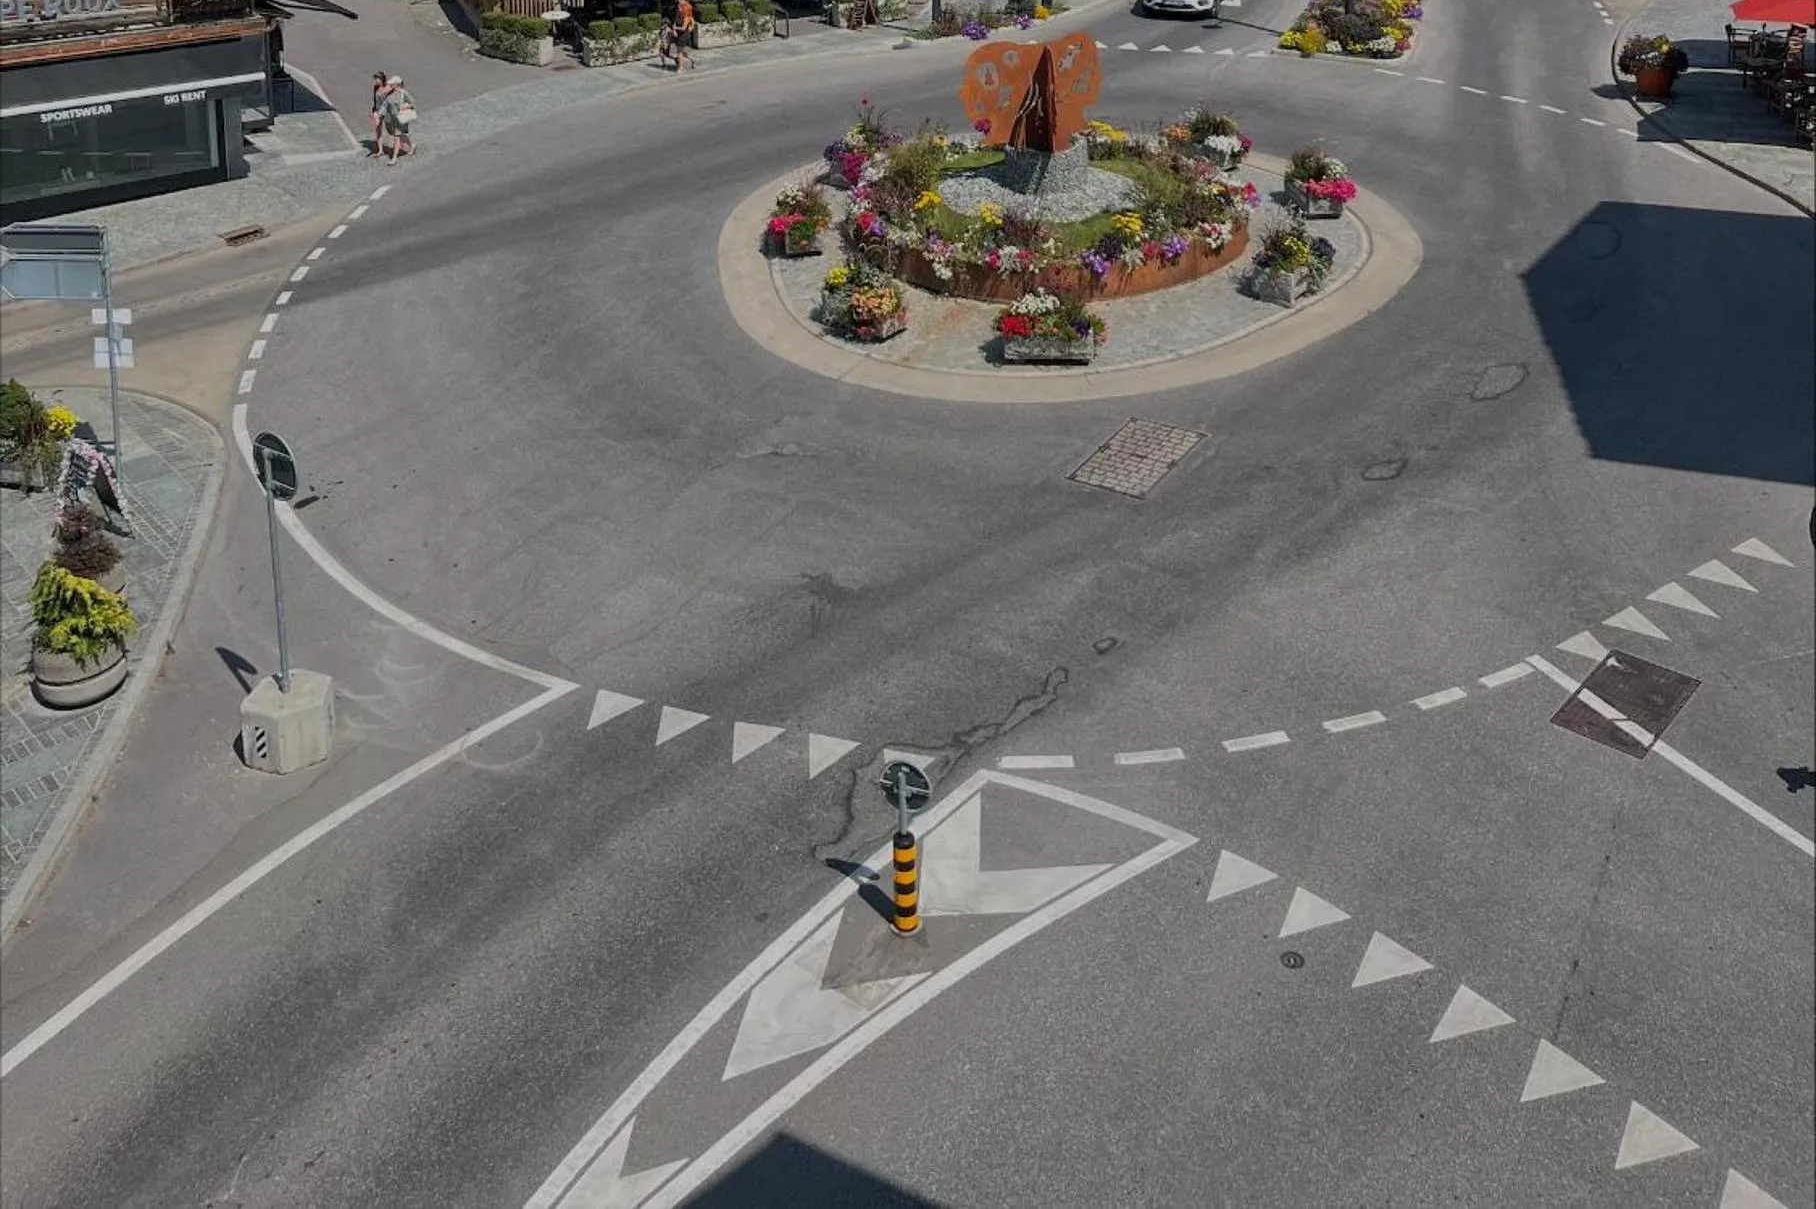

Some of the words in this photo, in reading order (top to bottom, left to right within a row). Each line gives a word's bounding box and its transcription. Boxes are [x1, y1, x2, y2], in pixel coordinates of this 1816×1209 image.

[163, 94, 180, 105] SKI
[181, 90, 207, 102] RENT
[40, 104, 113, 123] SPORTSWEAR
